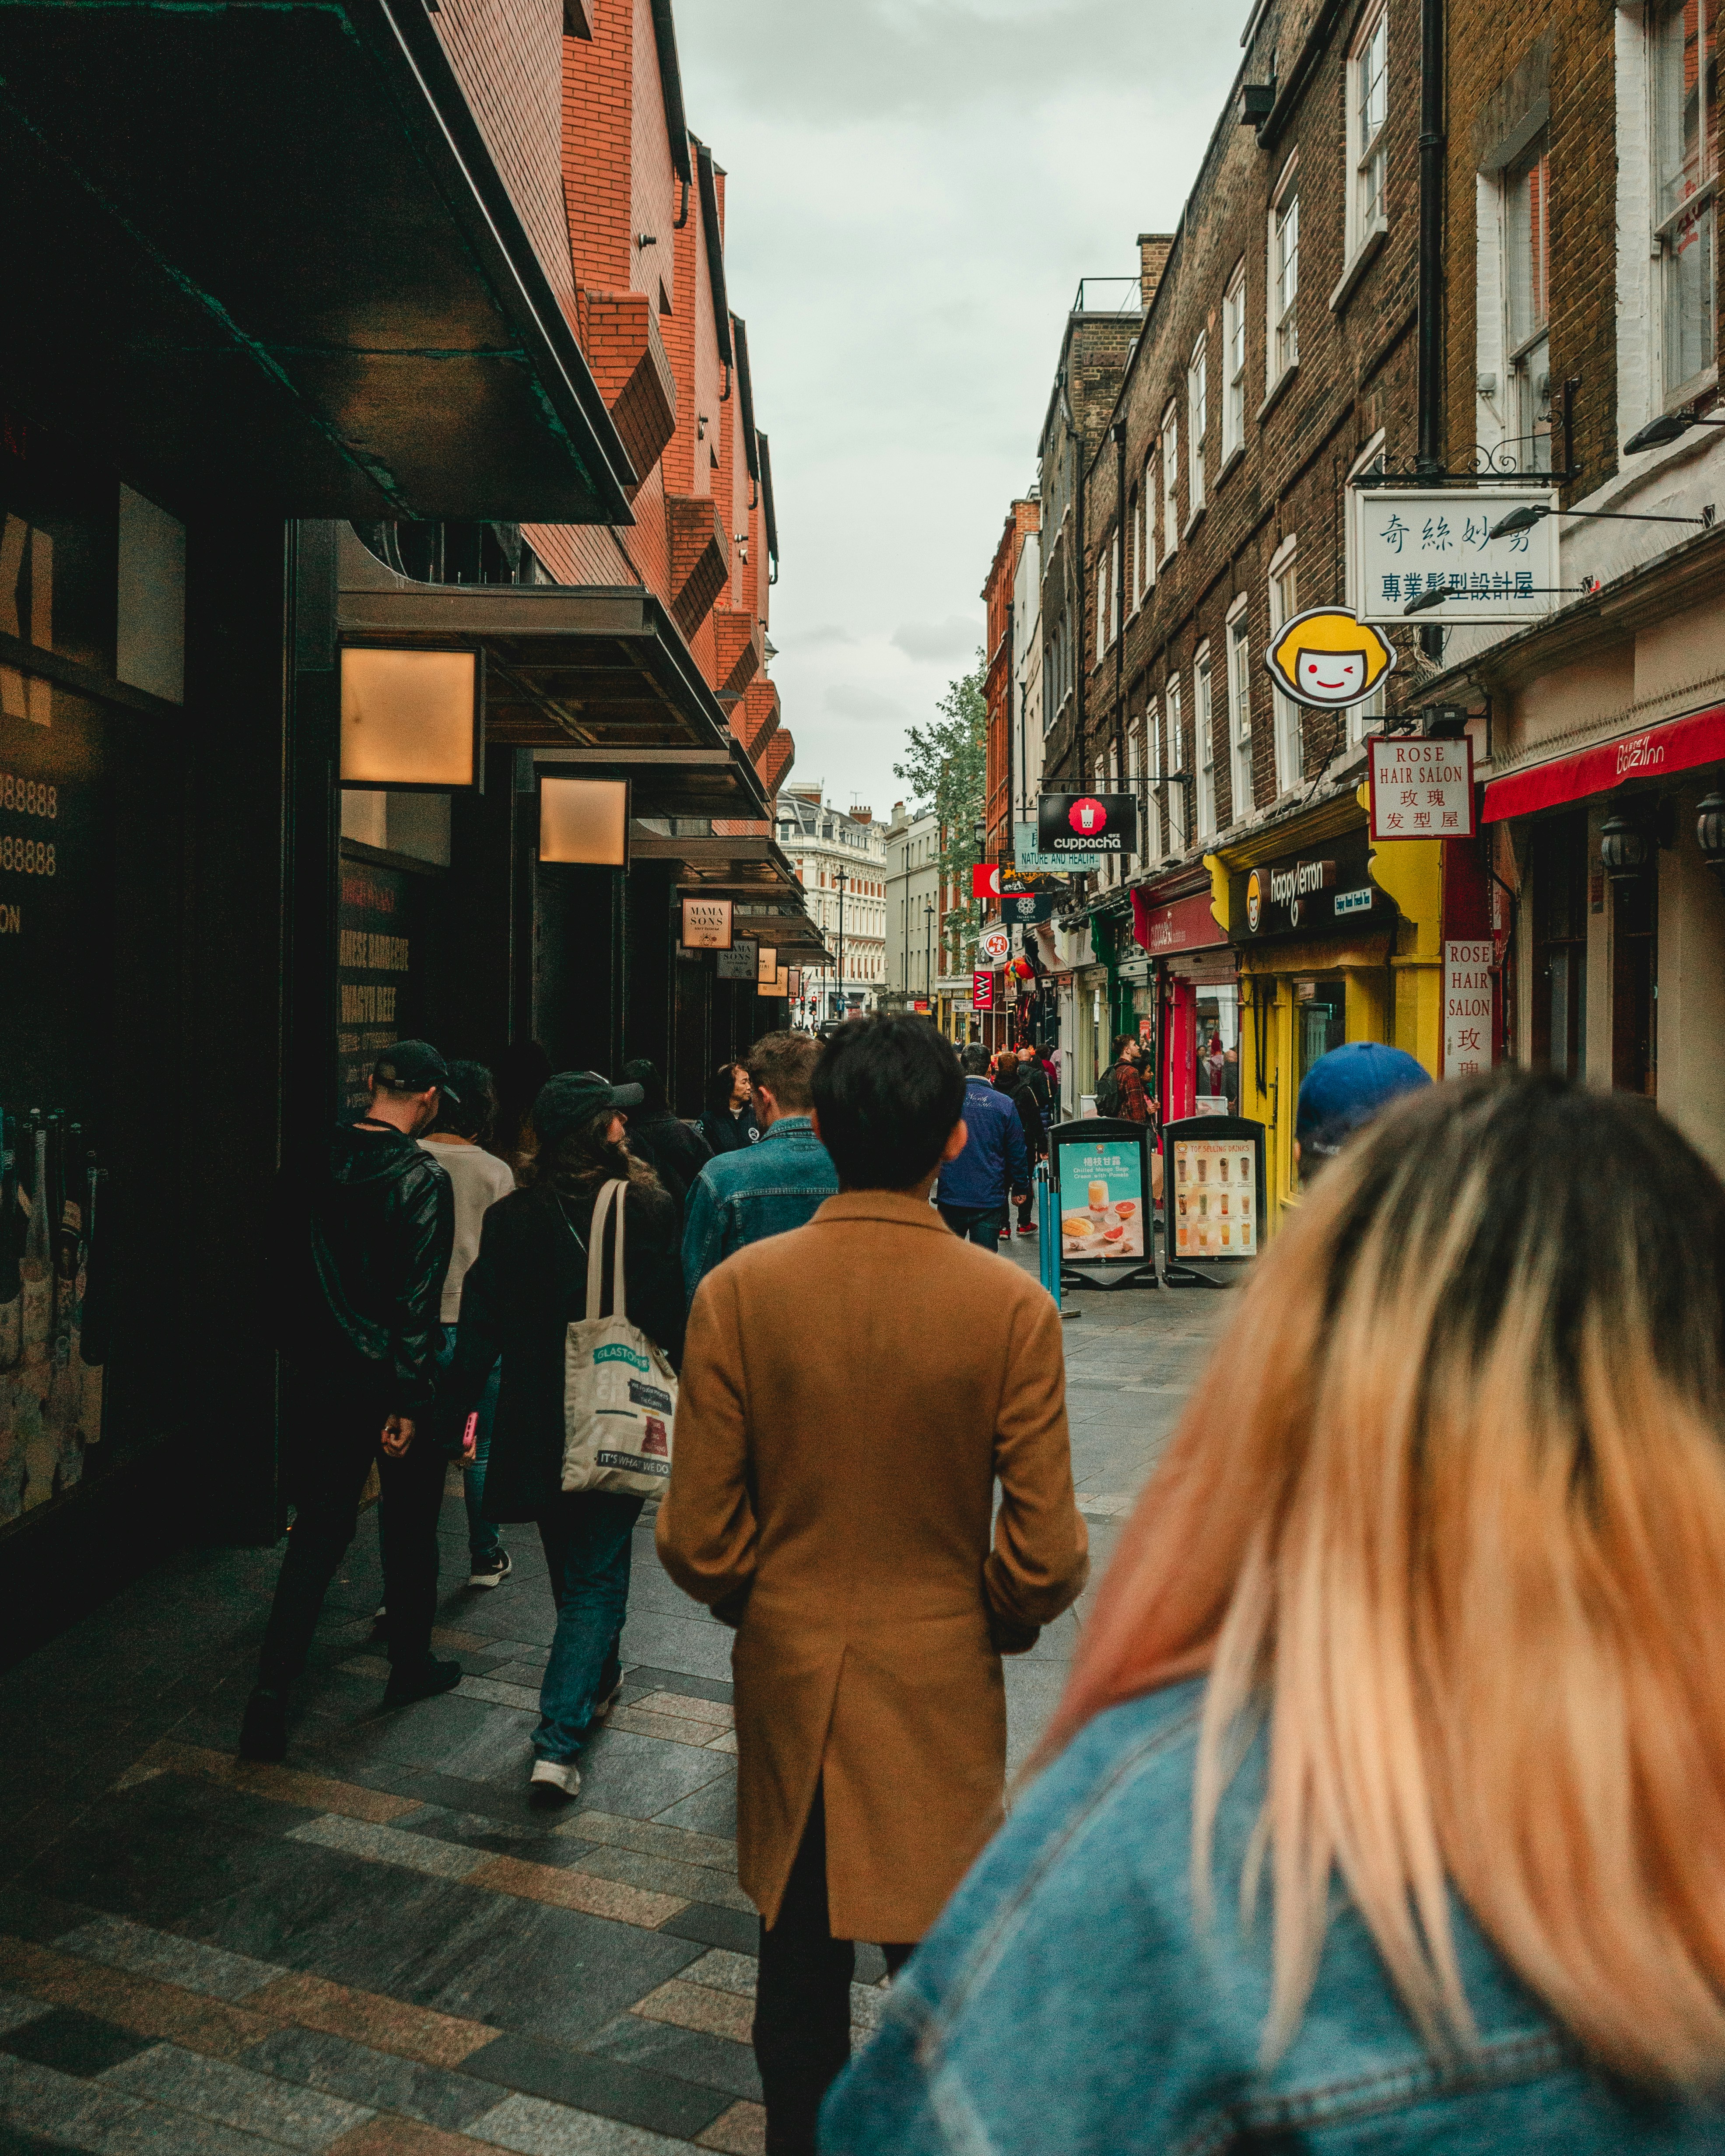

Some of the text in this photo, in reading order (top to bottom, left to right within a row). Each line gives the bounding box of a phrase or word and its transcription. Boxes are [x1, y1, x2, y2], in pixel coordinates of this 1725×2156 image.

[1395, 747, 1445, 762] ROSE
[1380, 766, 1462, 784] HAIR SALON
[1400, 788, 1446, 807] 玫瑰
[1386, 811, 1460, 830] 发型屋
[1054, 836, 1121, 850] cuppacha
[1021, 853, 1094, 865] NATURE AND HEALTH
[1271, 861, 1323, 927] happy lemon
[691, 907, 723, 915] MAMA
[690, 917, 722, 926] SONS
[368, 933, 409, 971] BARBECUE
[1450, 946, 1490, 963] ROSE
[1452, 972, 1488, 989] HAIR
[341, 984, 397, 1023] WAGYU BEEF
[1448, 999, 1490, 1016] SALON
[597, 1347, 648, 1368] GLASTO
[600, 1453, 618, 1464] IT'S
[643, 1461, 655, 1472] WE
[656, 1463, 669, 1474] DO
